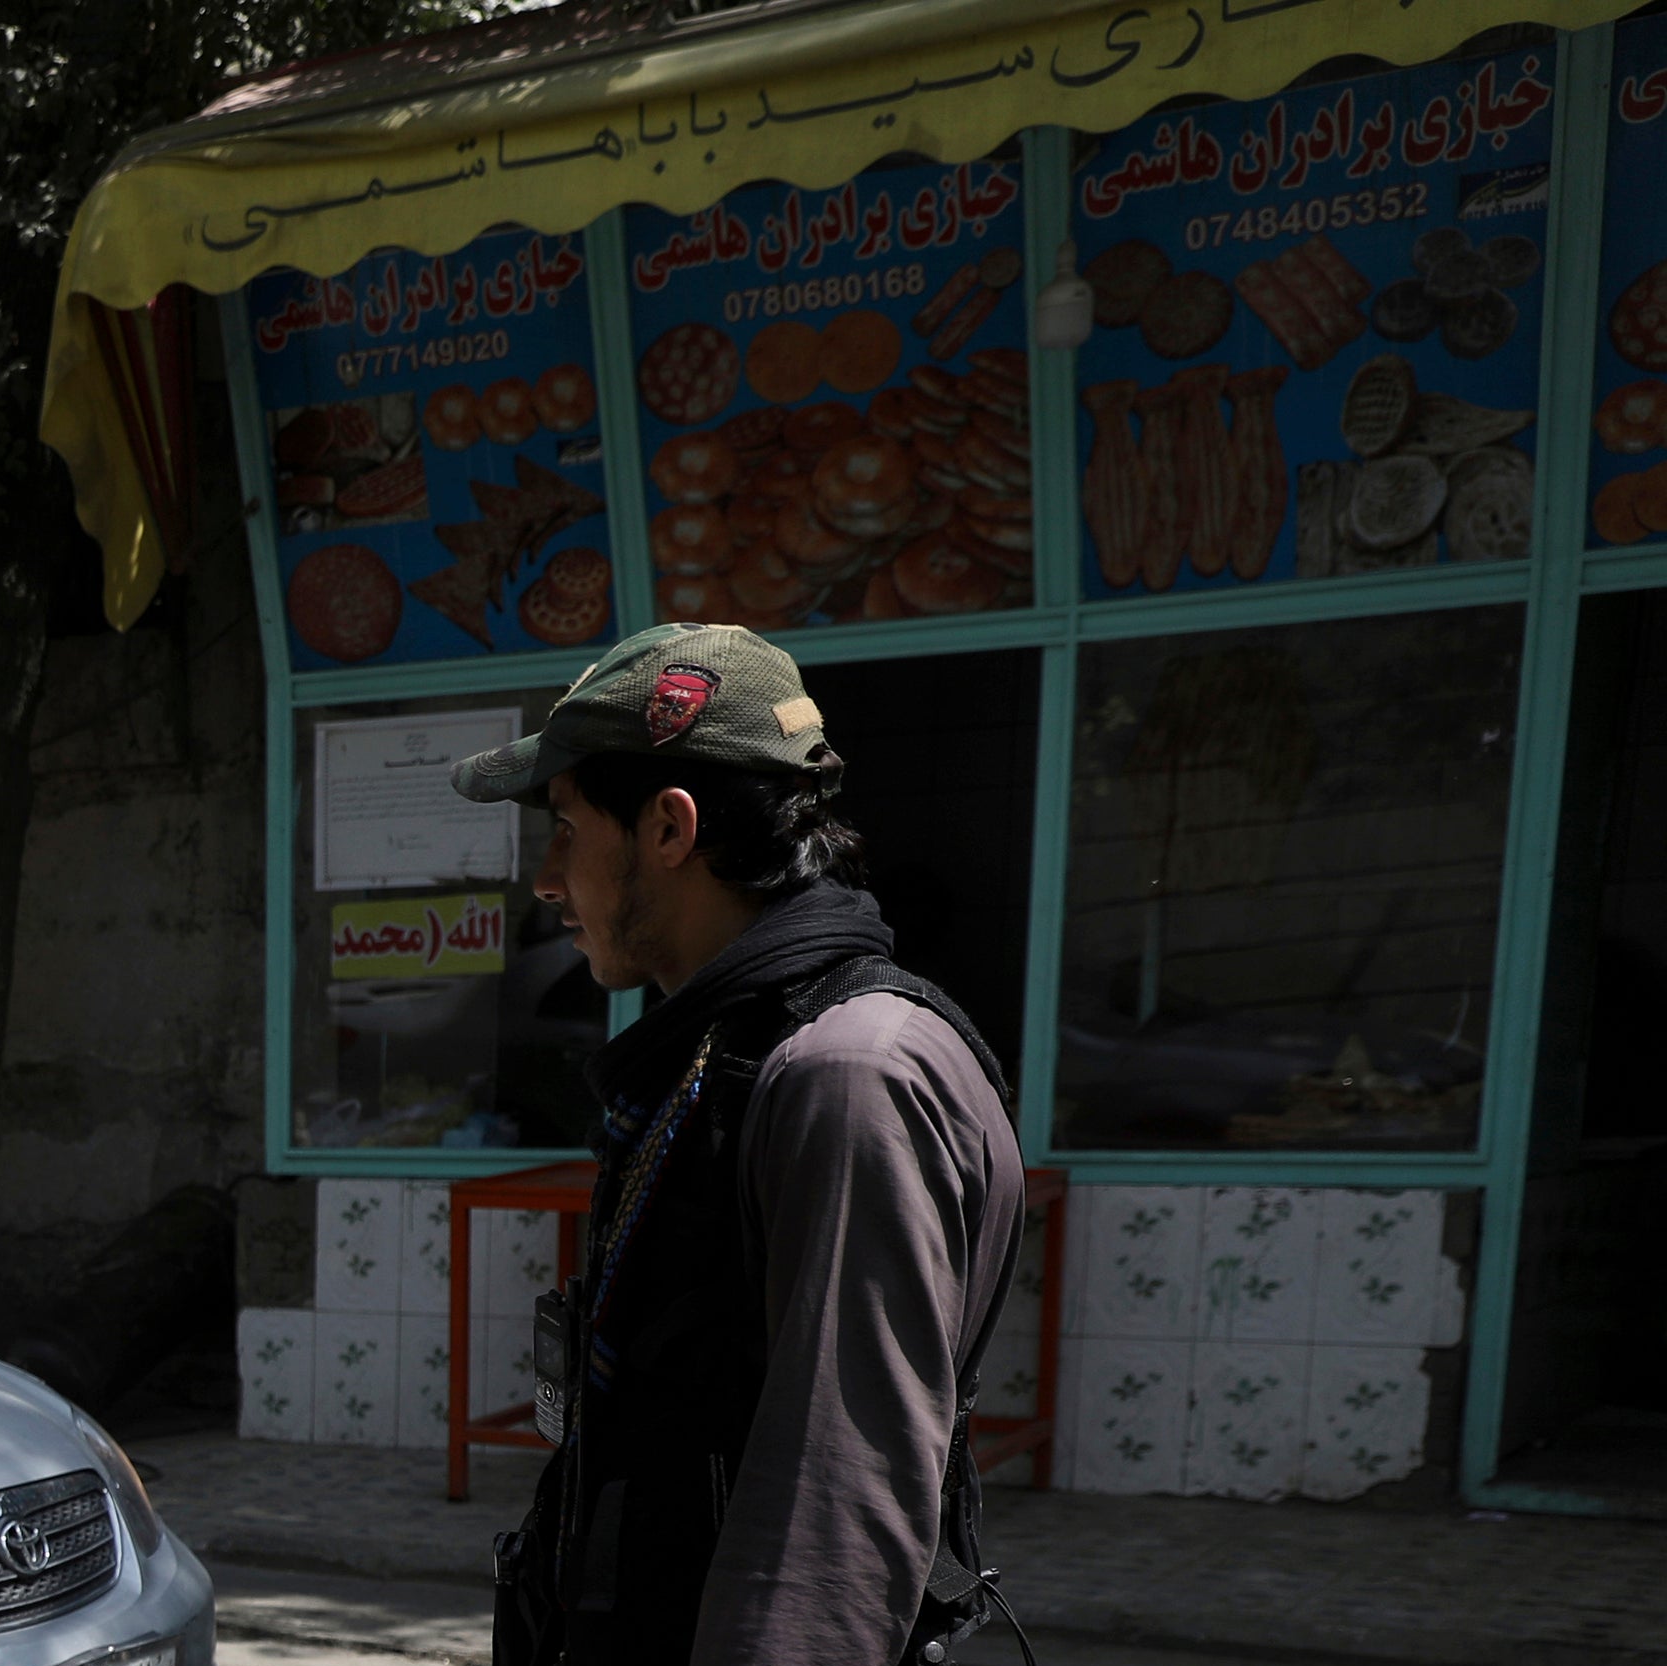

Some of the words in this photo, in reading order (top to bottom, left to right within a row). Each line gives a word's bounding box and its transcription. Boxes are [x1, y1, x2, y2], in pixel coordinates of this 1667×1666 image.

[1227, 88, 1394, 194] برادران
[1402, 56, 1555, 168] خبازی
[898, 164, 1019, 250] خبازی
[1081, 118, 1223, 218] هاشمی
[632, 207, 752, 292] هاشمی
[756, 183, 892, 272] برادران
[1184, 182, 1430, 252] 0748405352
[722, 261, 927, 324] 0780680168
[336, 331, 511, 390] 0777149020
